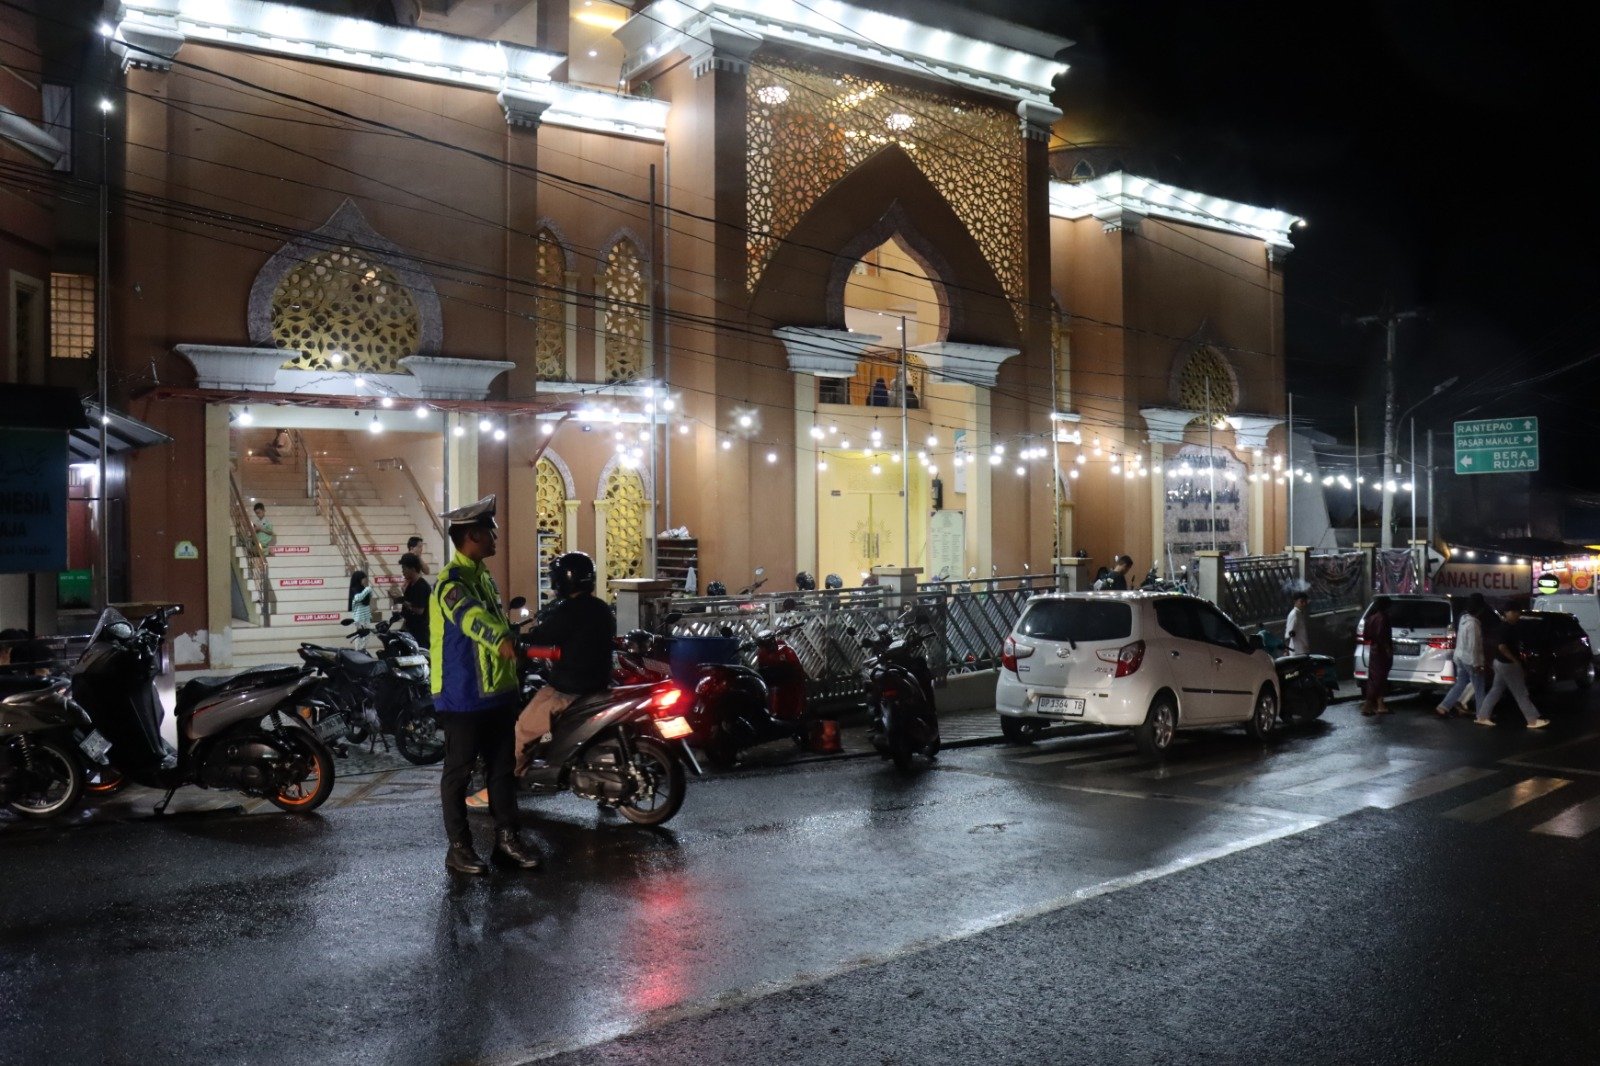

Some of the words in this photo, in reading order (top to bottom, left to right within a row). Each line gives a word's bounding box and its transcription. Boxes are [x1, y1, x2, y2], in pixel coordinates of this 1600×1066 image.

[1457, 423, 1513, 433] RANTEPAO
[1458, 438, 1484, 447] PASAR
[1485, 436, 1519, 445] MAKALE
[1493, 451, 1529, 459] BERA
[1493, 460, 1535, 468] RUJAB
[1482, 573, 1519, 589] CELL
